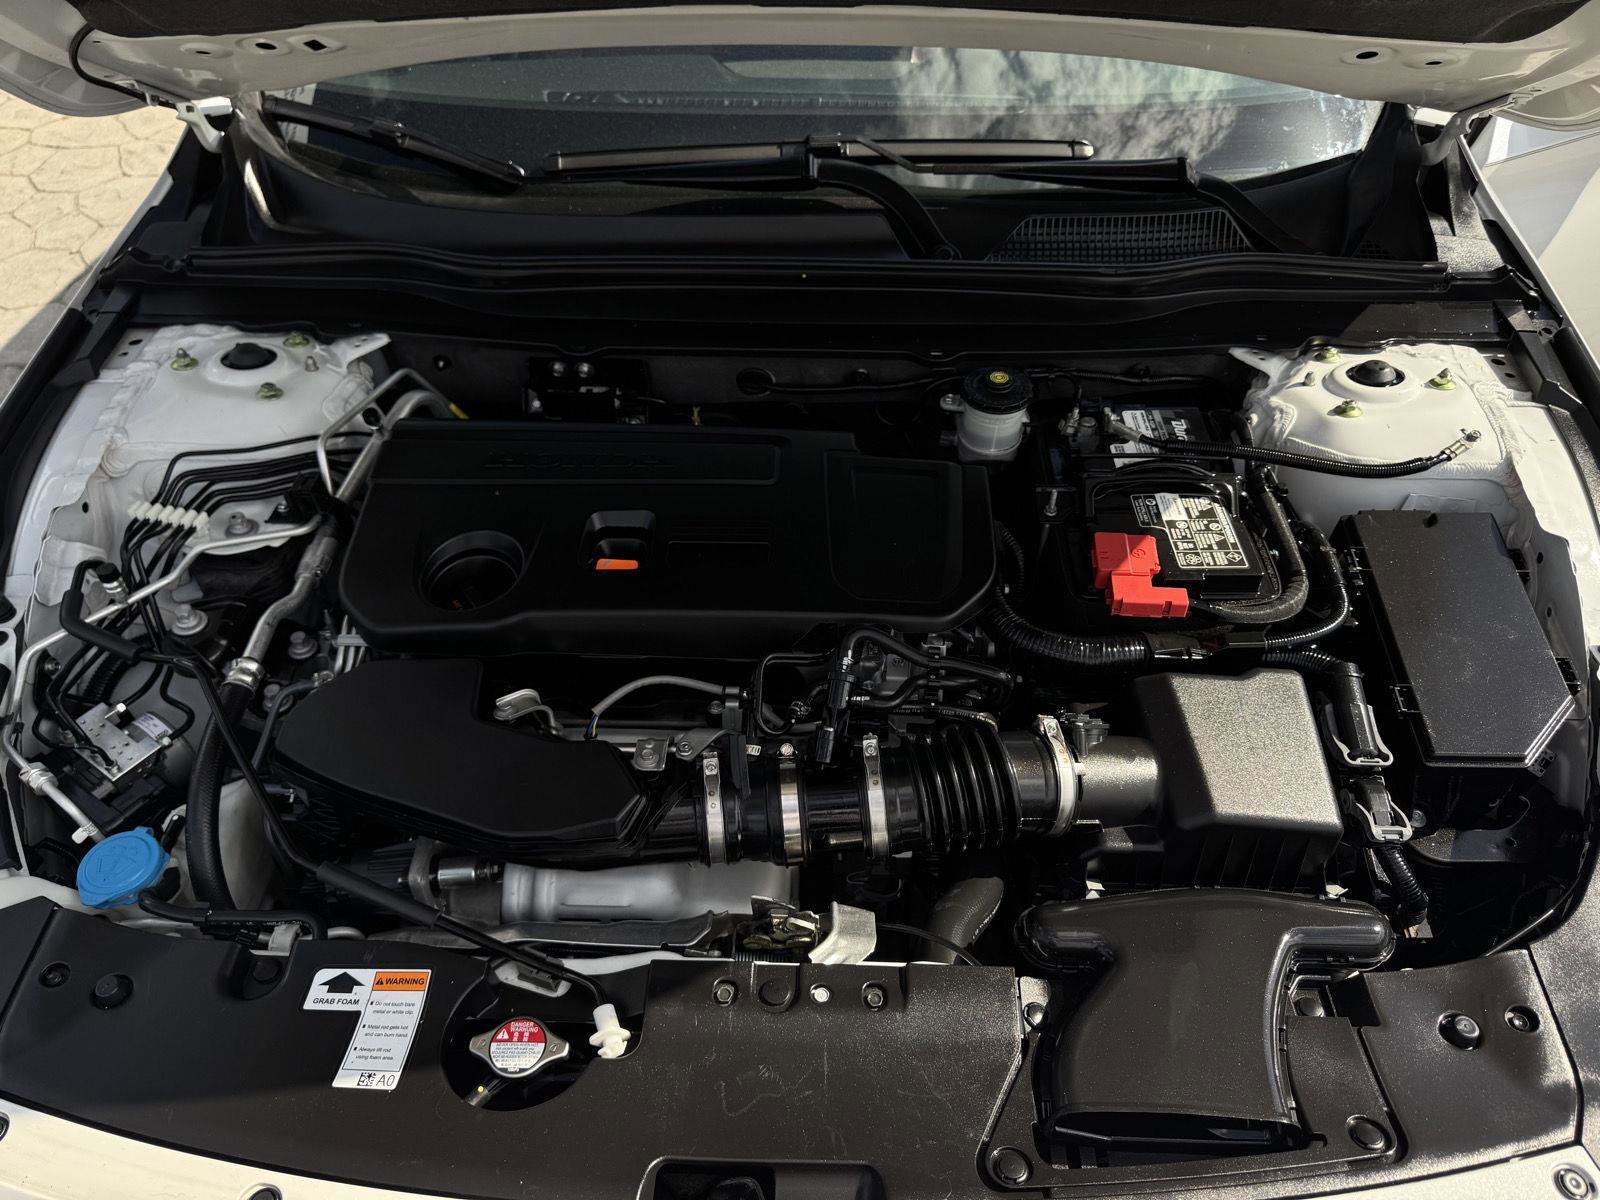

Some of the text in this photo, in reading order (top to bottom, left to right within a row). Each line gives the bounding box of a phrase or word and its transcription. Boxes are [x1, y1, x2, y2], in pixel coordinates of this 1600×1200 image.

[385, 977, 425, 985] WARNING
[336, 998, 360, 1006] FOAM
[376, 1074, 396, 1087] A0
